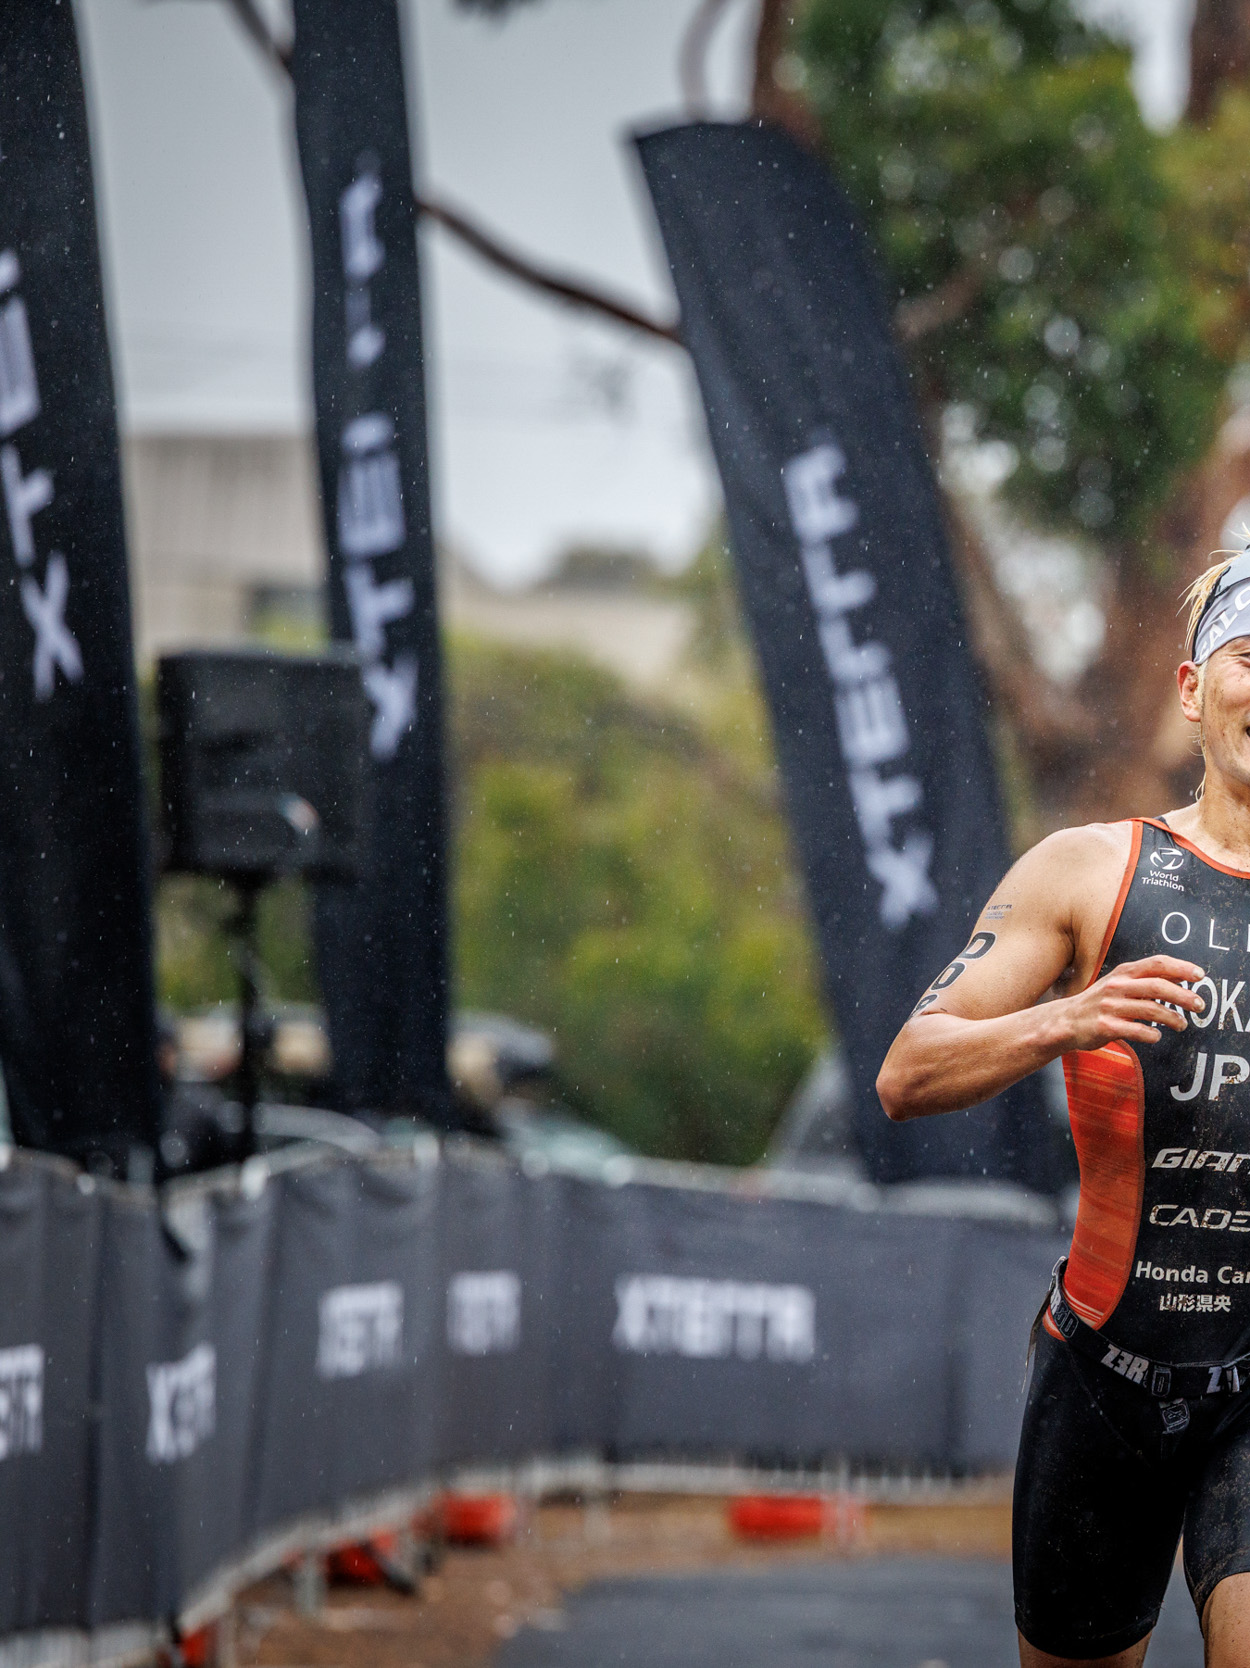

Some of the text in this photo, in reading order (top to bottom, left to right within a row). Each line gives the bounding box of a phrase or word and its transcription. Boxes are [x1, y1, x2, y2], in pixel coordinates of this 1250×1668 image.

[1141, 877, 1185, 891] Triathlon
[1150, 870, 1179, 882] World
[1135, 1260, 1209, 1284] Honda
[1159, 1292, 1232, 1313] 山形県央
